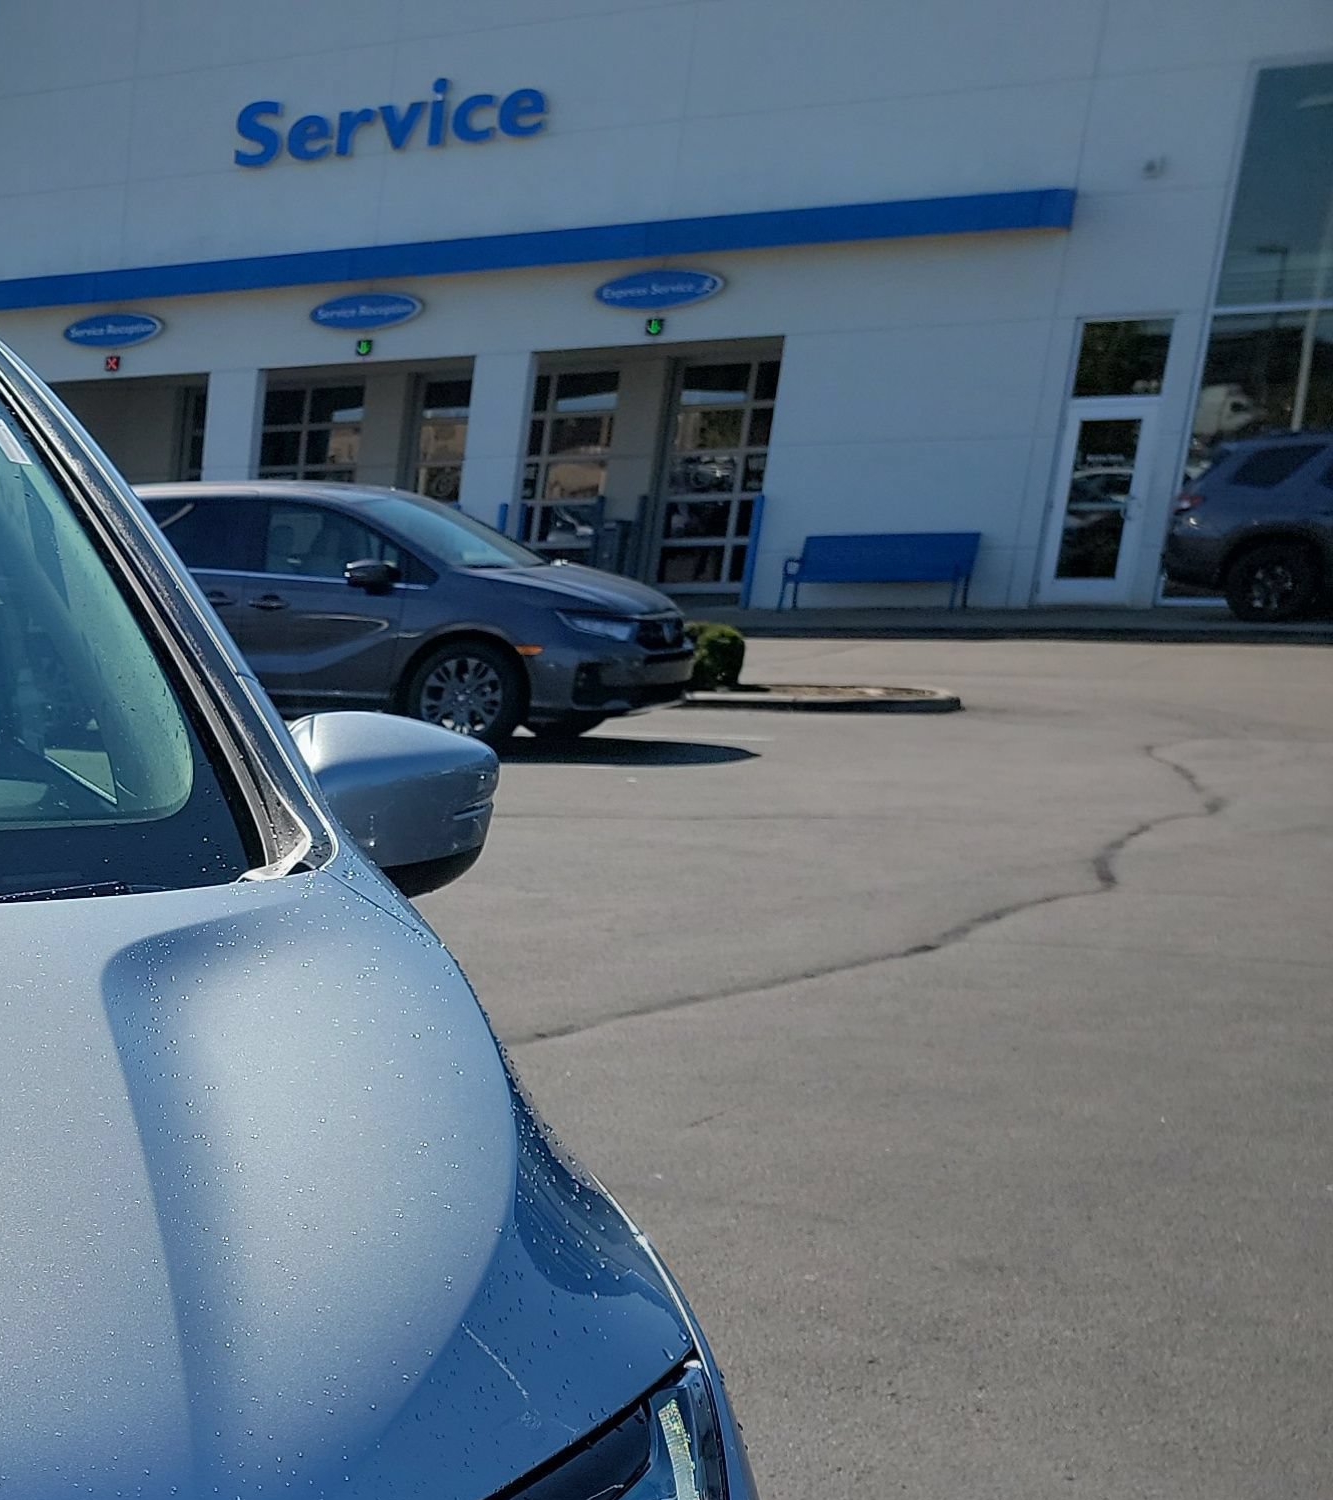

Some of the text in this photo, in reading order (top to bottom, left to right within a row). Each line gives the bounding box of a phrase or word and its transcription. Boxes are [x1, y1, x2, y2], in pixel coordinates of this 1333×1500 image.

[234, 77, 550, 168] Service
[650, 283, 694, 295] Service
[317, 308, 357, 320] Service
[69, 328, 105, 338] Service
